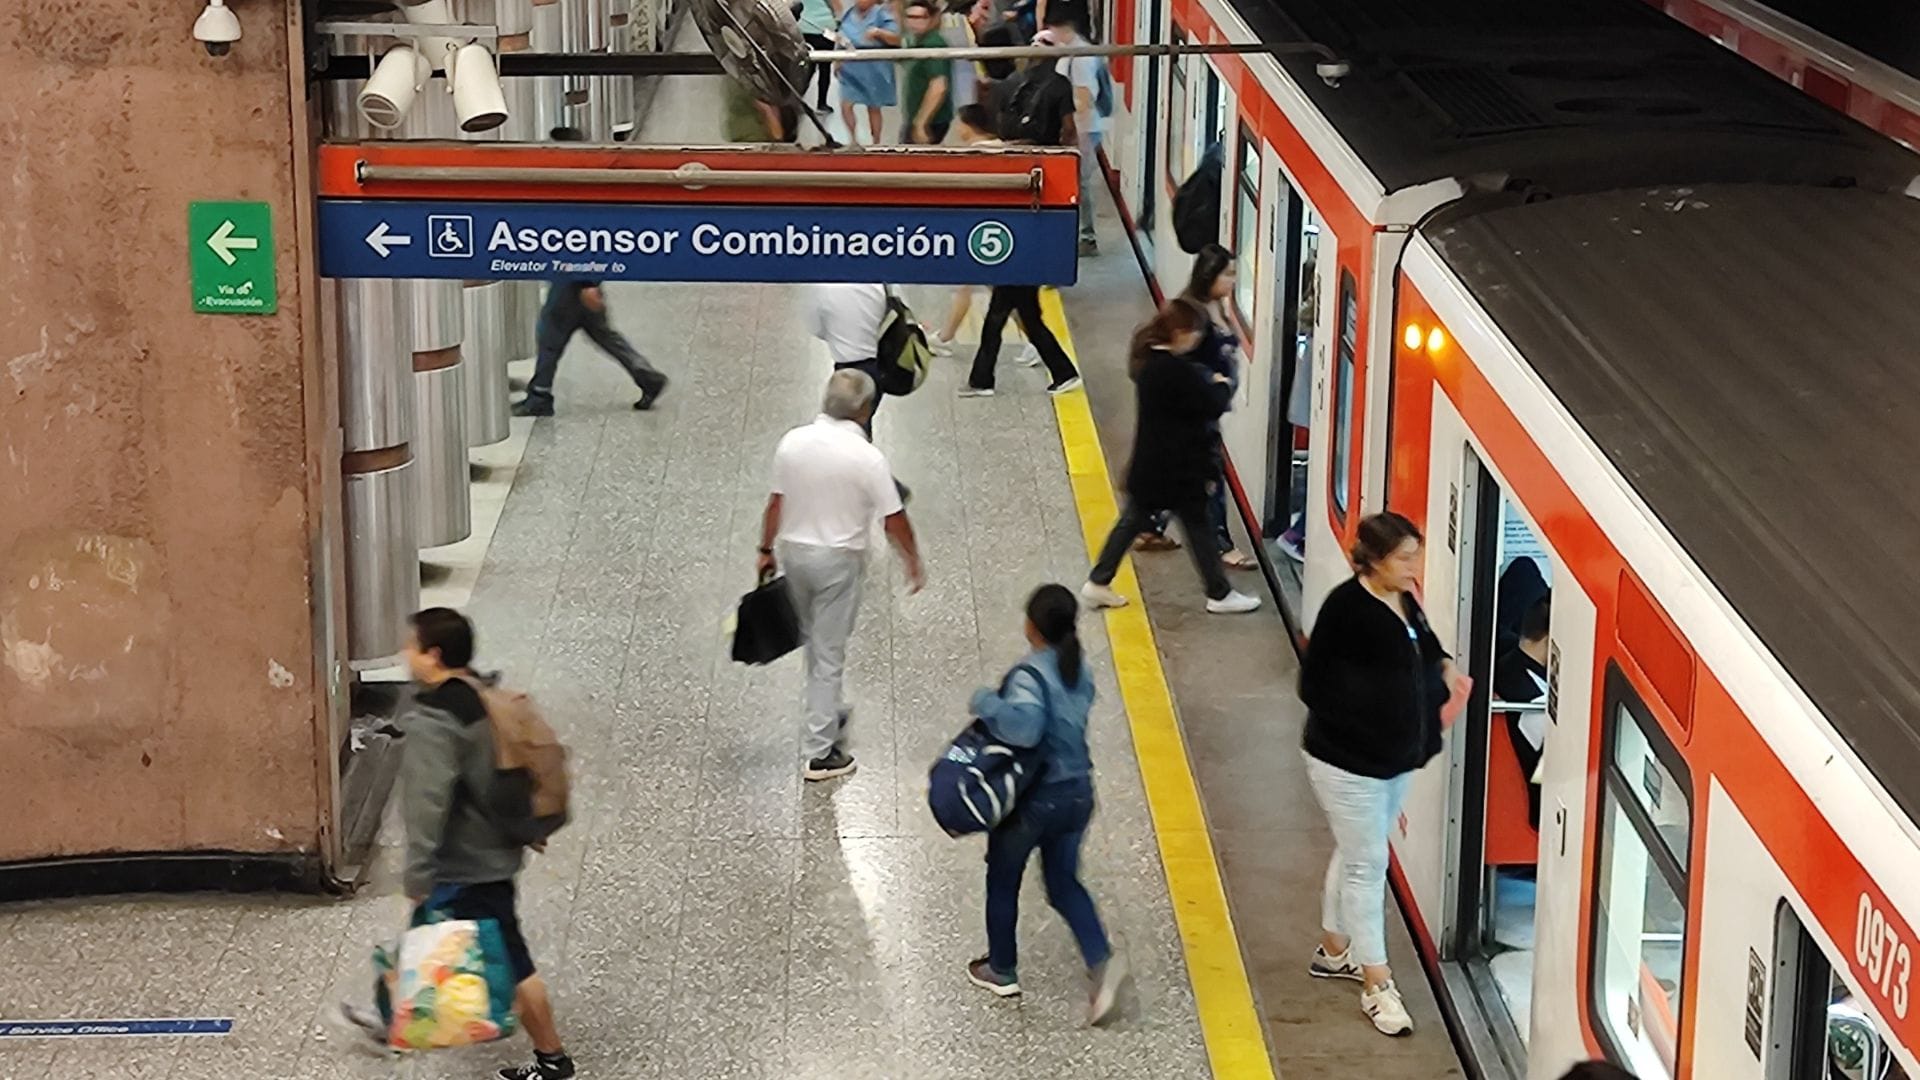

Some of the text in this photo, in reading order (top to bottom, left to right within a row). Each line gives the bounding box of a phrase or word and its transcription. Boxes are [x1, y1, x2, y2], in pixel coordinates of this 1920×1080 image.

[487, 220, 1002, 258] Ascensor Combinación 5
[491, 259, 627, 274] Elevator Transfer to
[1855, 892, 1912, 1020] 0973
[8, 1026, 73, 1034] Service
[77, 1025, 129, 1033] Office
